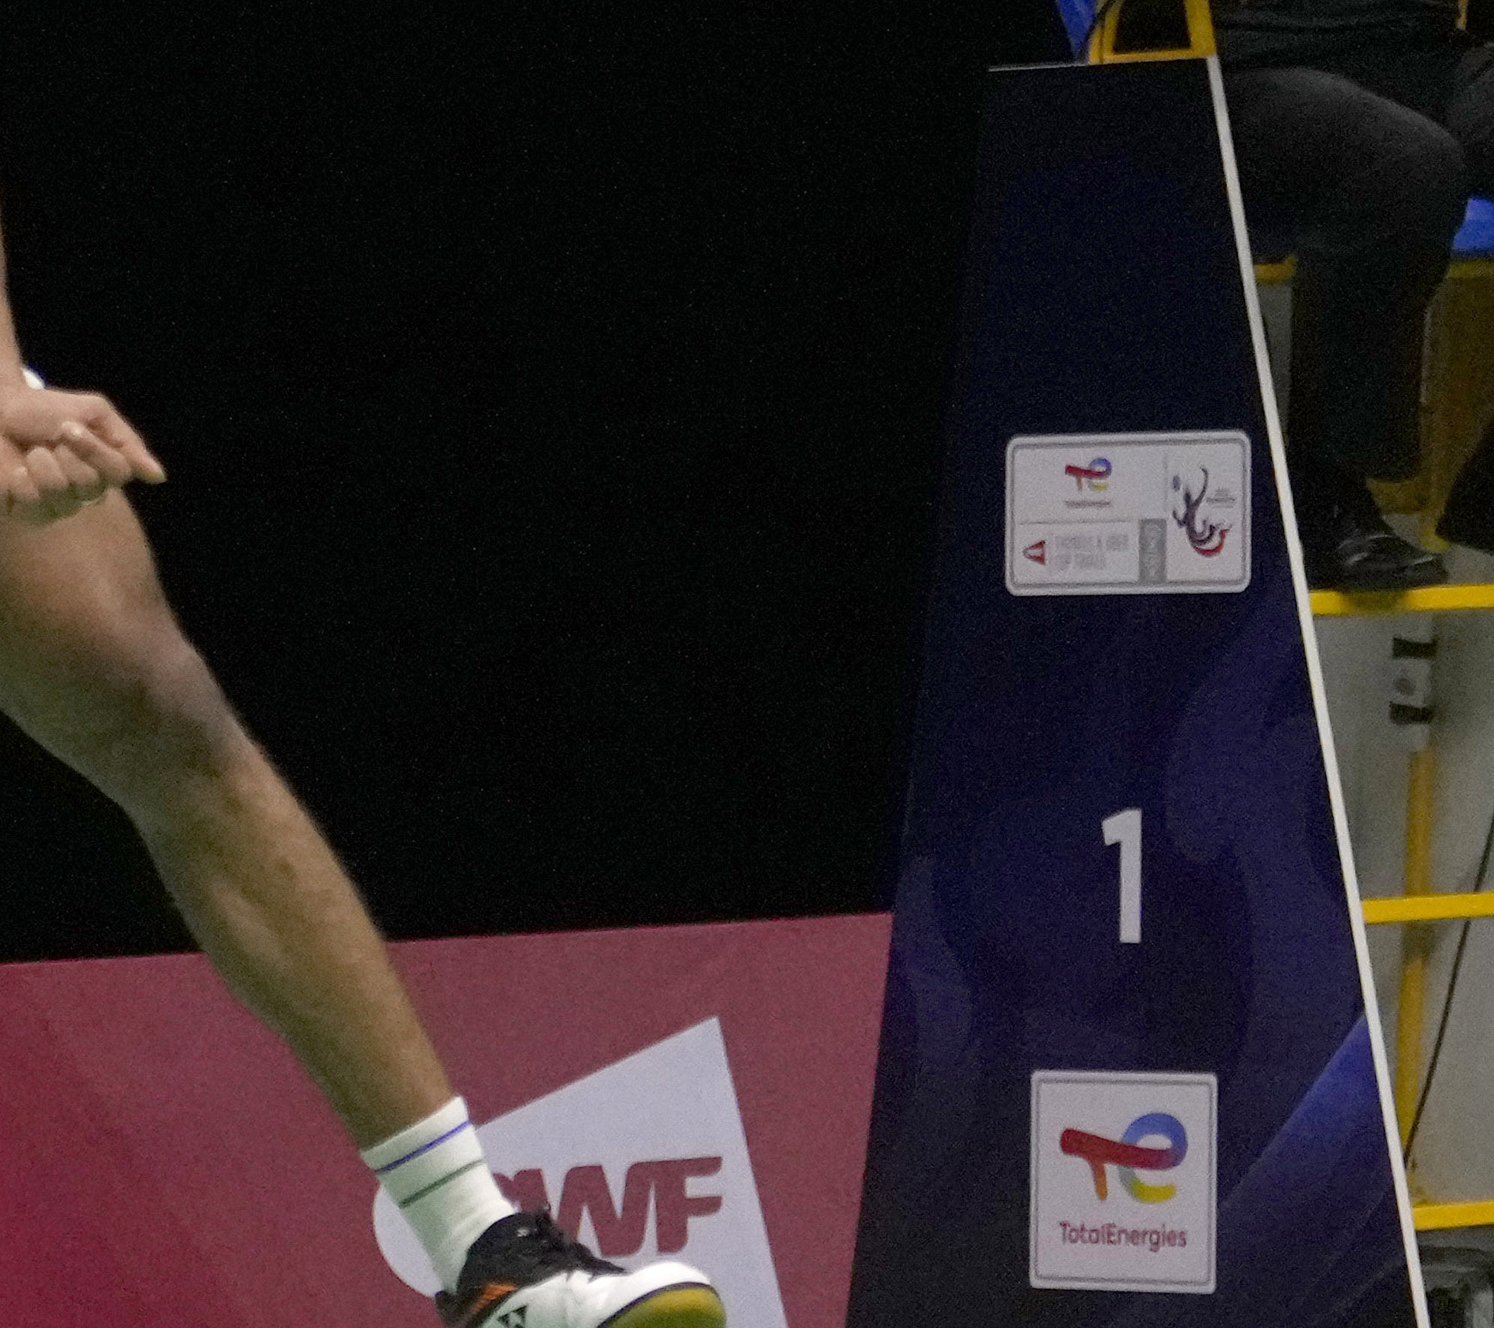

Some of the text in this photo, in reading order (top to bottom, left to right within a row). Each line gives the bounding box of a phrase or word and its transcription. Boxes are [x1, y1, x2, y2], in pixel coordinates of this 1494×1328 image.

[1102, 809, 1143, 944] 1
[493, 1156, 723, 1257] WF
[1059, 1220, 1188, 1253] TotalEnergies
